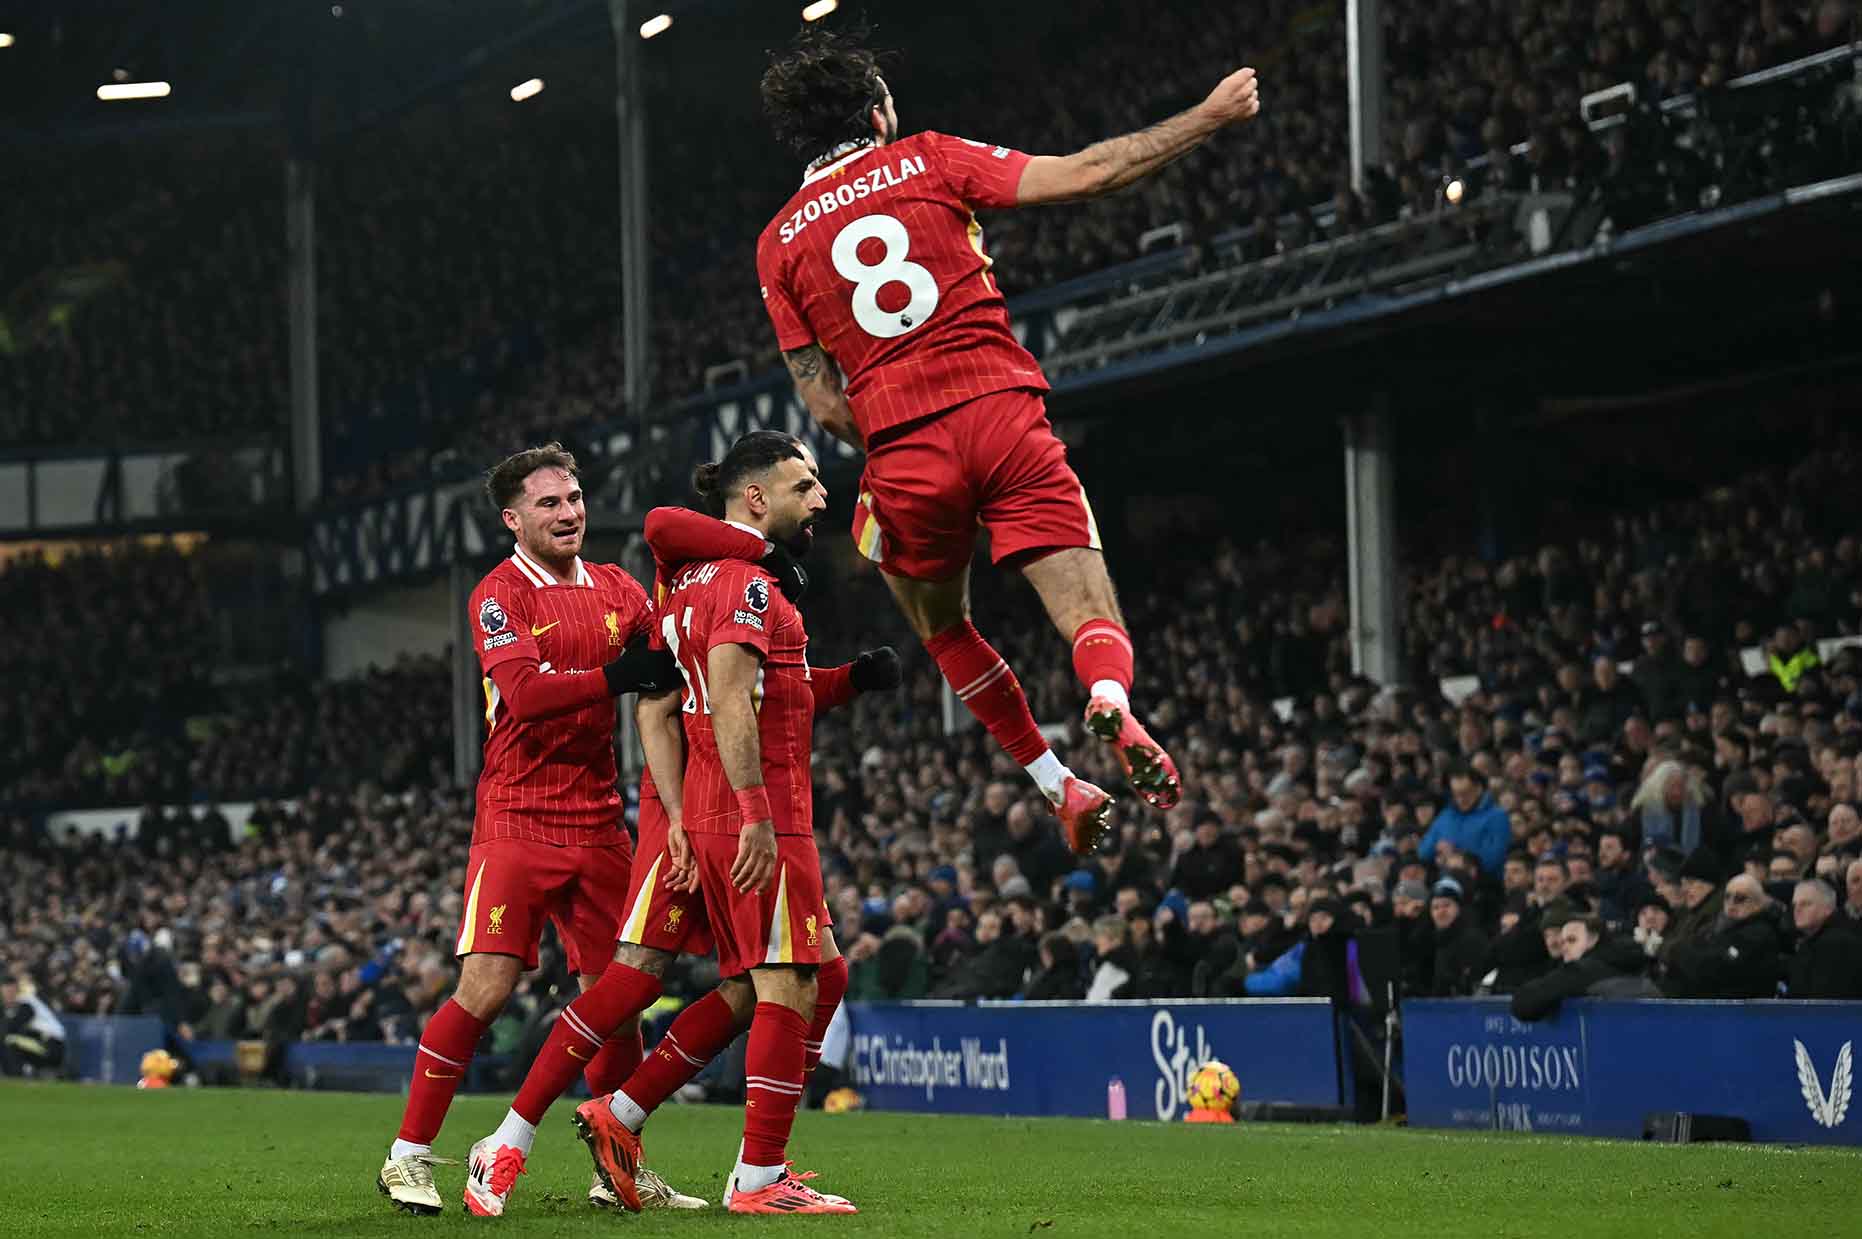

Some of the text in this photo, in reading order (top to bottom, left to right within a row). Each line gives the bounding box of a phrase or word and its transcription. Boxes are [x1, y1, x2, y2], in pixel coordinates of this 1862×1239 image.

[779, 156, 926, 244] SZOBOSZLAI
[831, 214, 940, 339] 8
[487, 927, 502, 935] LFC
[870, 1035, 1009, 1102] Christopher Ward
[1447, 1043, 1579, 1089] GOODISON
